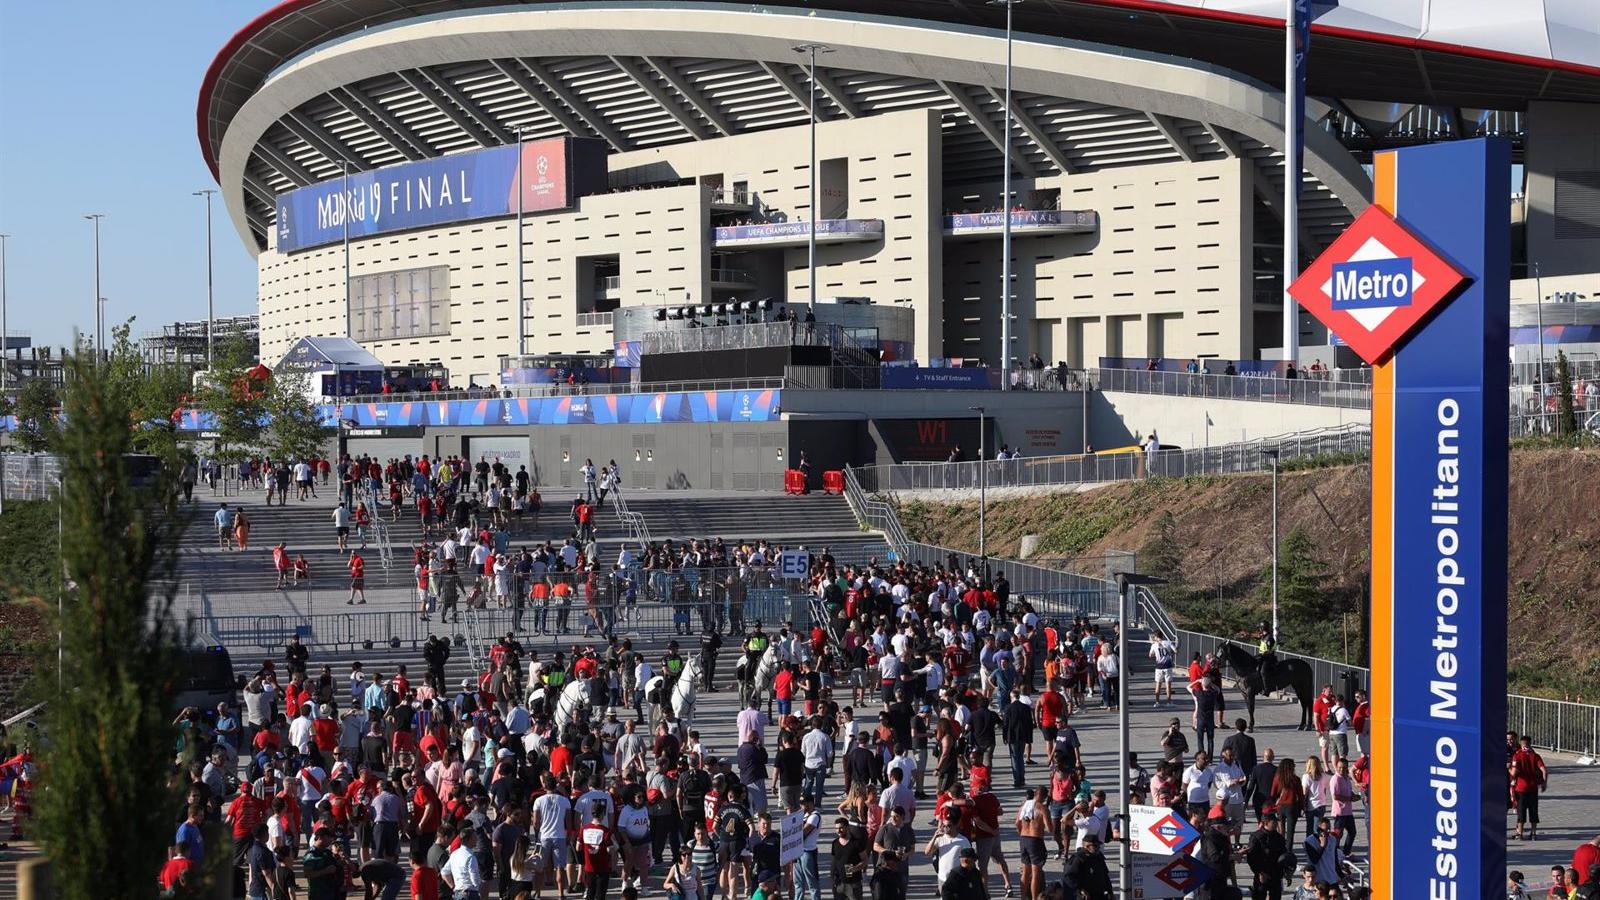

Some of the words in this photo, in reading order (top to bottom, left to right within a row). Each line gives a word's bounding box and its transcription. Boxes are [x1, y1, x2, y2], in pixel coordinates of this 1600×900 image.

[370, 182, 381, 223] 19
[391, 170, 472, 214] FINAL
[748, 227, 765, 236] UEFA
[765, 226, 801, 236] CHAMPIONS
[804, 224, 830, 233] LEGUE
[1336, 270, 1408, 301] Metro
[918, 420, 946, 443] W1
[783, 556, 807, 574] E5
[1430, 398, 1465, 720] Metropolitano
[956, 654, 962, 664] 11
[633, 818, 648, 826] AIA
[725, 818, 735, 835] 4
[1430, 736, 1457, 900] Estadio
[1162, 827, 1177, 835] Metro
